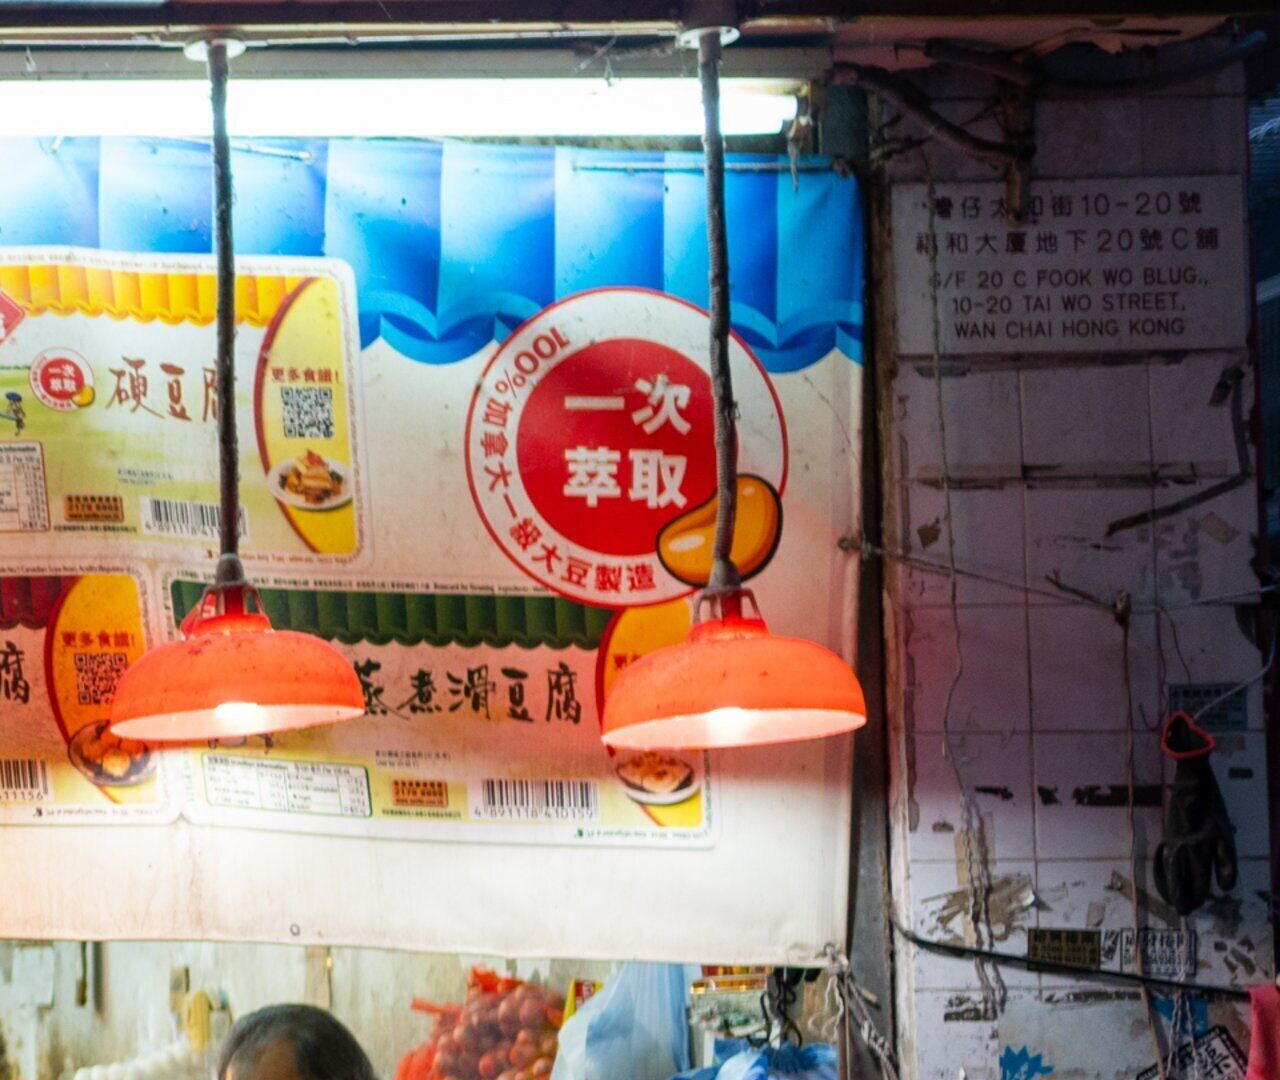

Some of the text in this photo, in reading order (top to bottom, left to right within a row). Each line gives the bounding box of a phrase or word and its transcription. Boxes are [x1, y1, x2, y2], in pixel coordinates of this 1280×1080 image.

[977, 270, 1003, 289] 20
[1013, 270, 1027, 288] C
[1036, 268, 1092, 288] FOOK
[1102, 267, 1134, 287] WO
[953, 295, 1012, 315] 10-20
[1023, 295, 1051, 312] TAI
[1062, 294, 1092, 312] WO
[954, 316, 1185, 339] WAN CHAI HONG KONG
[563, 372, 692, 435] 一次
[562, 445, 689, 509] 萃取
